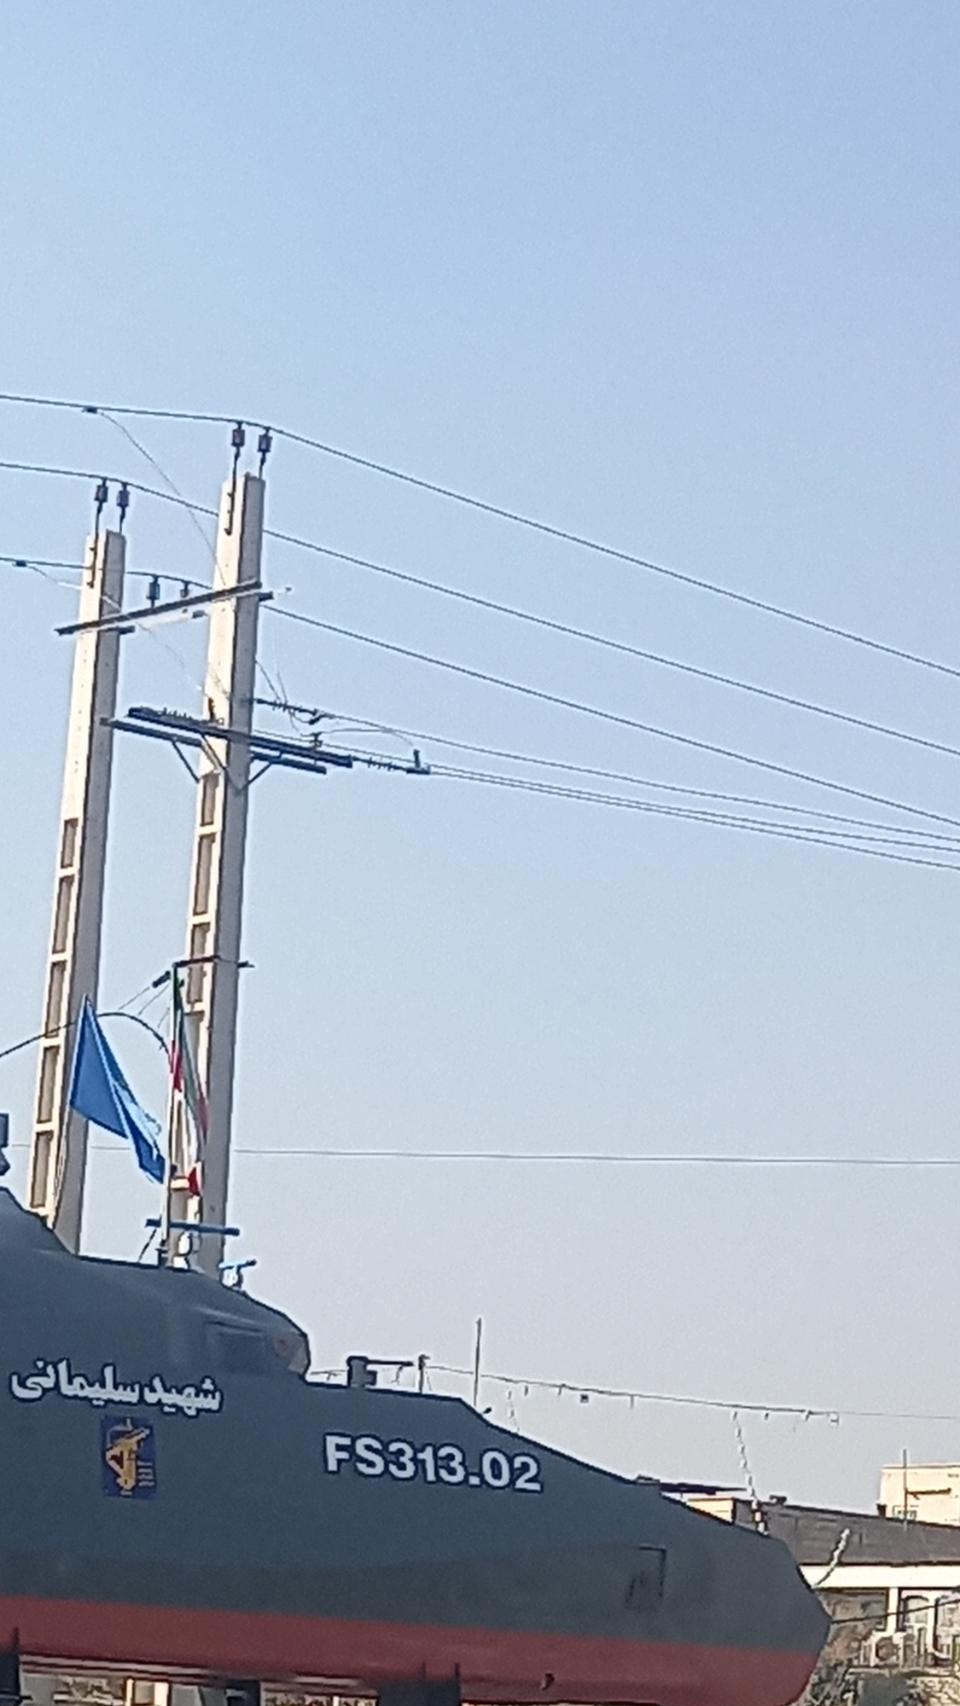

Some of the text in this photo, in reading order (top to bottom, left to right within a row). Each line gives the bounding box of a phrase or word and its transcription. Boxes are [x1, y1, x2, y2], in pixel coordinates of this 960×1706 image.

[11, 1358, 221, 1416] شهید سلیمانی
[324, 1434, 541, 1491] FS313.02
